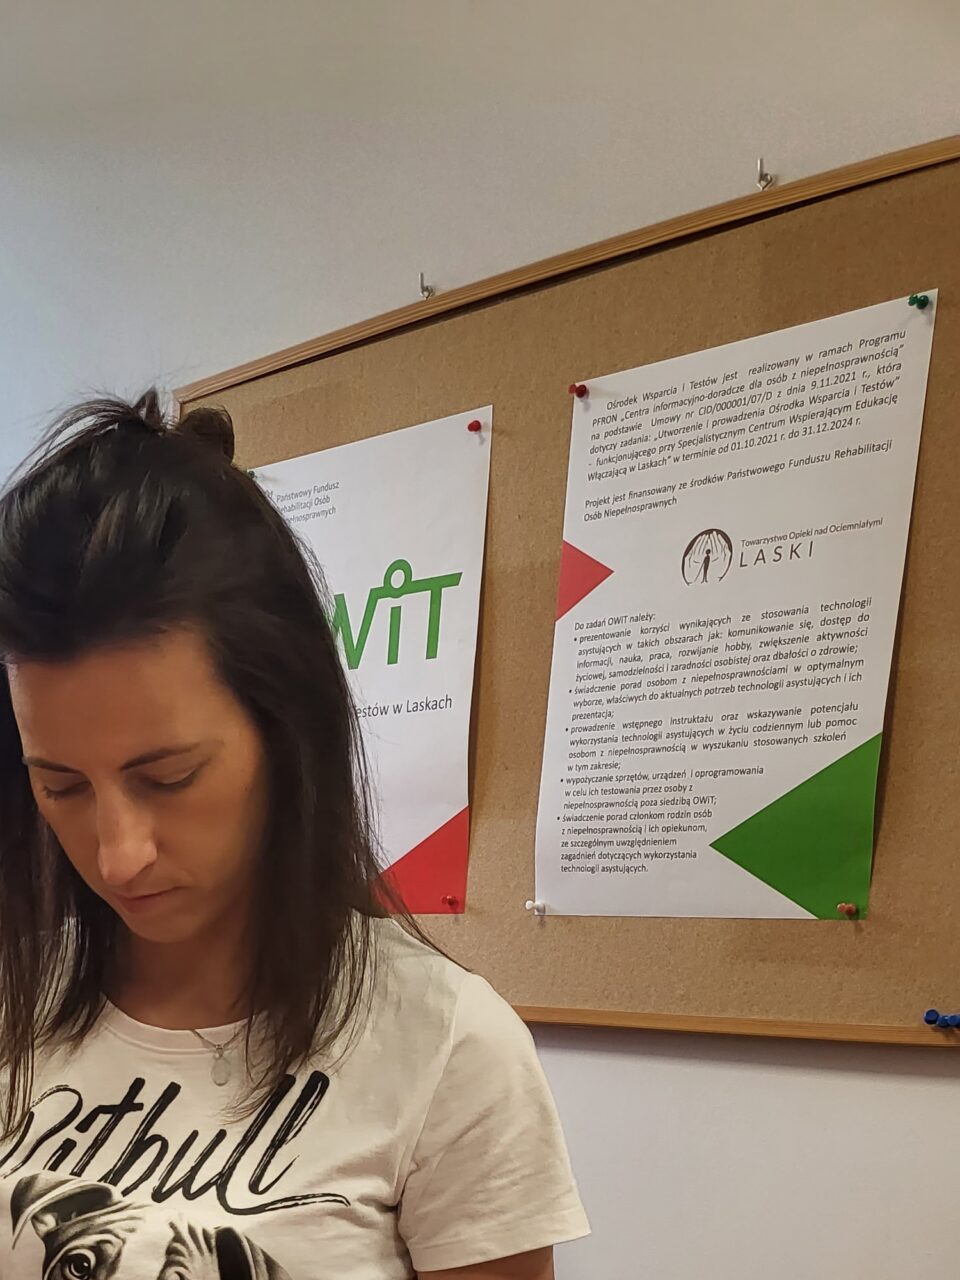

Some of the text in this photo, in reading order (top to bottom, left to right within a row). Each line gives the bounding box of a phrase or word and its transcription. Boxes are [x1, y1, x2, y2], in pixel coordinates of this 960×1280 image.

[606, 394, 638, 410] Ośrodek
[642, 384, 677, 404] Wsparcia
[687, 376, 718, 390] Testów
[721, 369, 738, 385] jest
[747, 356, 800, 378] realizowany
[805, 352, 813, 362] w
[818, 341, 853, 359] ramach
[857, 329, 906, 352] Programu
[590, 431, 600, 441] na
[603, 419, 643, 440] podstawie
[649, 409, 681, 430] Umowy
[684, 409, 693, 419] nr
[776, 388, 782, 398] z
[786, 380, 806, 396] dnia
[810, 367, 857, 390] 9.11.2021
[875, 358, 901, 375] która
[592, 410, 618, 427] PFRON
[651, 380, 746, 416] informacyjno-doradcze
[748, 376, 763, 390] dla
[765, 369, 788, 386] osób
[790, 371, 796, 380] z
[589, 438, 618, 455] dotyczy
[710, 404, 766, 430] prowadzenia
[767, 395, 805, 415] Ośrodka
[807, 384, 851, 408] Wsparcia
[595, 390, 898, 468] funkcjonującego przy Specjalistycznym Centrum Wspierającym Edukację
[587, 462, 628, 481] Włączającą
[628, 463, 637, 472] w
[672, 454, 680, 463] w
[681, 443, 717, 461] terminie
[717, 441, 729, 454] od
[730, 430, 777, 451] 01.10.2021
[787, 425, 800, 439] do
[801, 413, 854, 436] 31.12.2024
[313, 481, 340, 495] Fundusz
[584, 439, 892, 510] Projekt jest finansowany ze środków Państwowego Funduszu Rehabilitacji
[314, 495, 331, 506] Osób
[583, 494, 677, 521] Osób Niepełnosprawnych
[738, 539, 813, 567] LASKI
[574, 622, 584, 631] Do
[585, 617, 606, 629] zadań
[607, 614, 627, 626] OWiT
[577, 640, 622, 658] asystujących
[625, 642, 633, 650] w
[636, 635, 660, 648] takich
[663, 630, 704, 645] obszarach
[726, 619, 795, 638] komunikowanie
[818, 611, 853, 629] dostęp
[856, 609, 869, 622] do
[578, 596, 872, 645] prezentowanie korzyści wynikających ze stosowania technologii
[677, 642, 719, 660] rozwijanie
[757, 631, 810, 651] zwiększenie
[815, 625, 868, 644] aktywności
[573, 655, 864, 695] świadczenie porad osobom z niepełnosprawnościami w optymalnym
[355, 694, 452, 718] estów w Laskach
[570, 700, 858, 735] prowadzenie wstępnego instruktażu oraz wskazywanie potencjału
[569, 717, 857, 748] wykorzystania technologii asystujących w życiu codziennym lub pomoc
[560, 848, 697, 862] zagadnień dotyczących wykorzystania
[569, 836, 615, 850] szczególnym
[614, 835, 677, 849] uwzględnieniem
[560, 862, 600, 874] technologii
